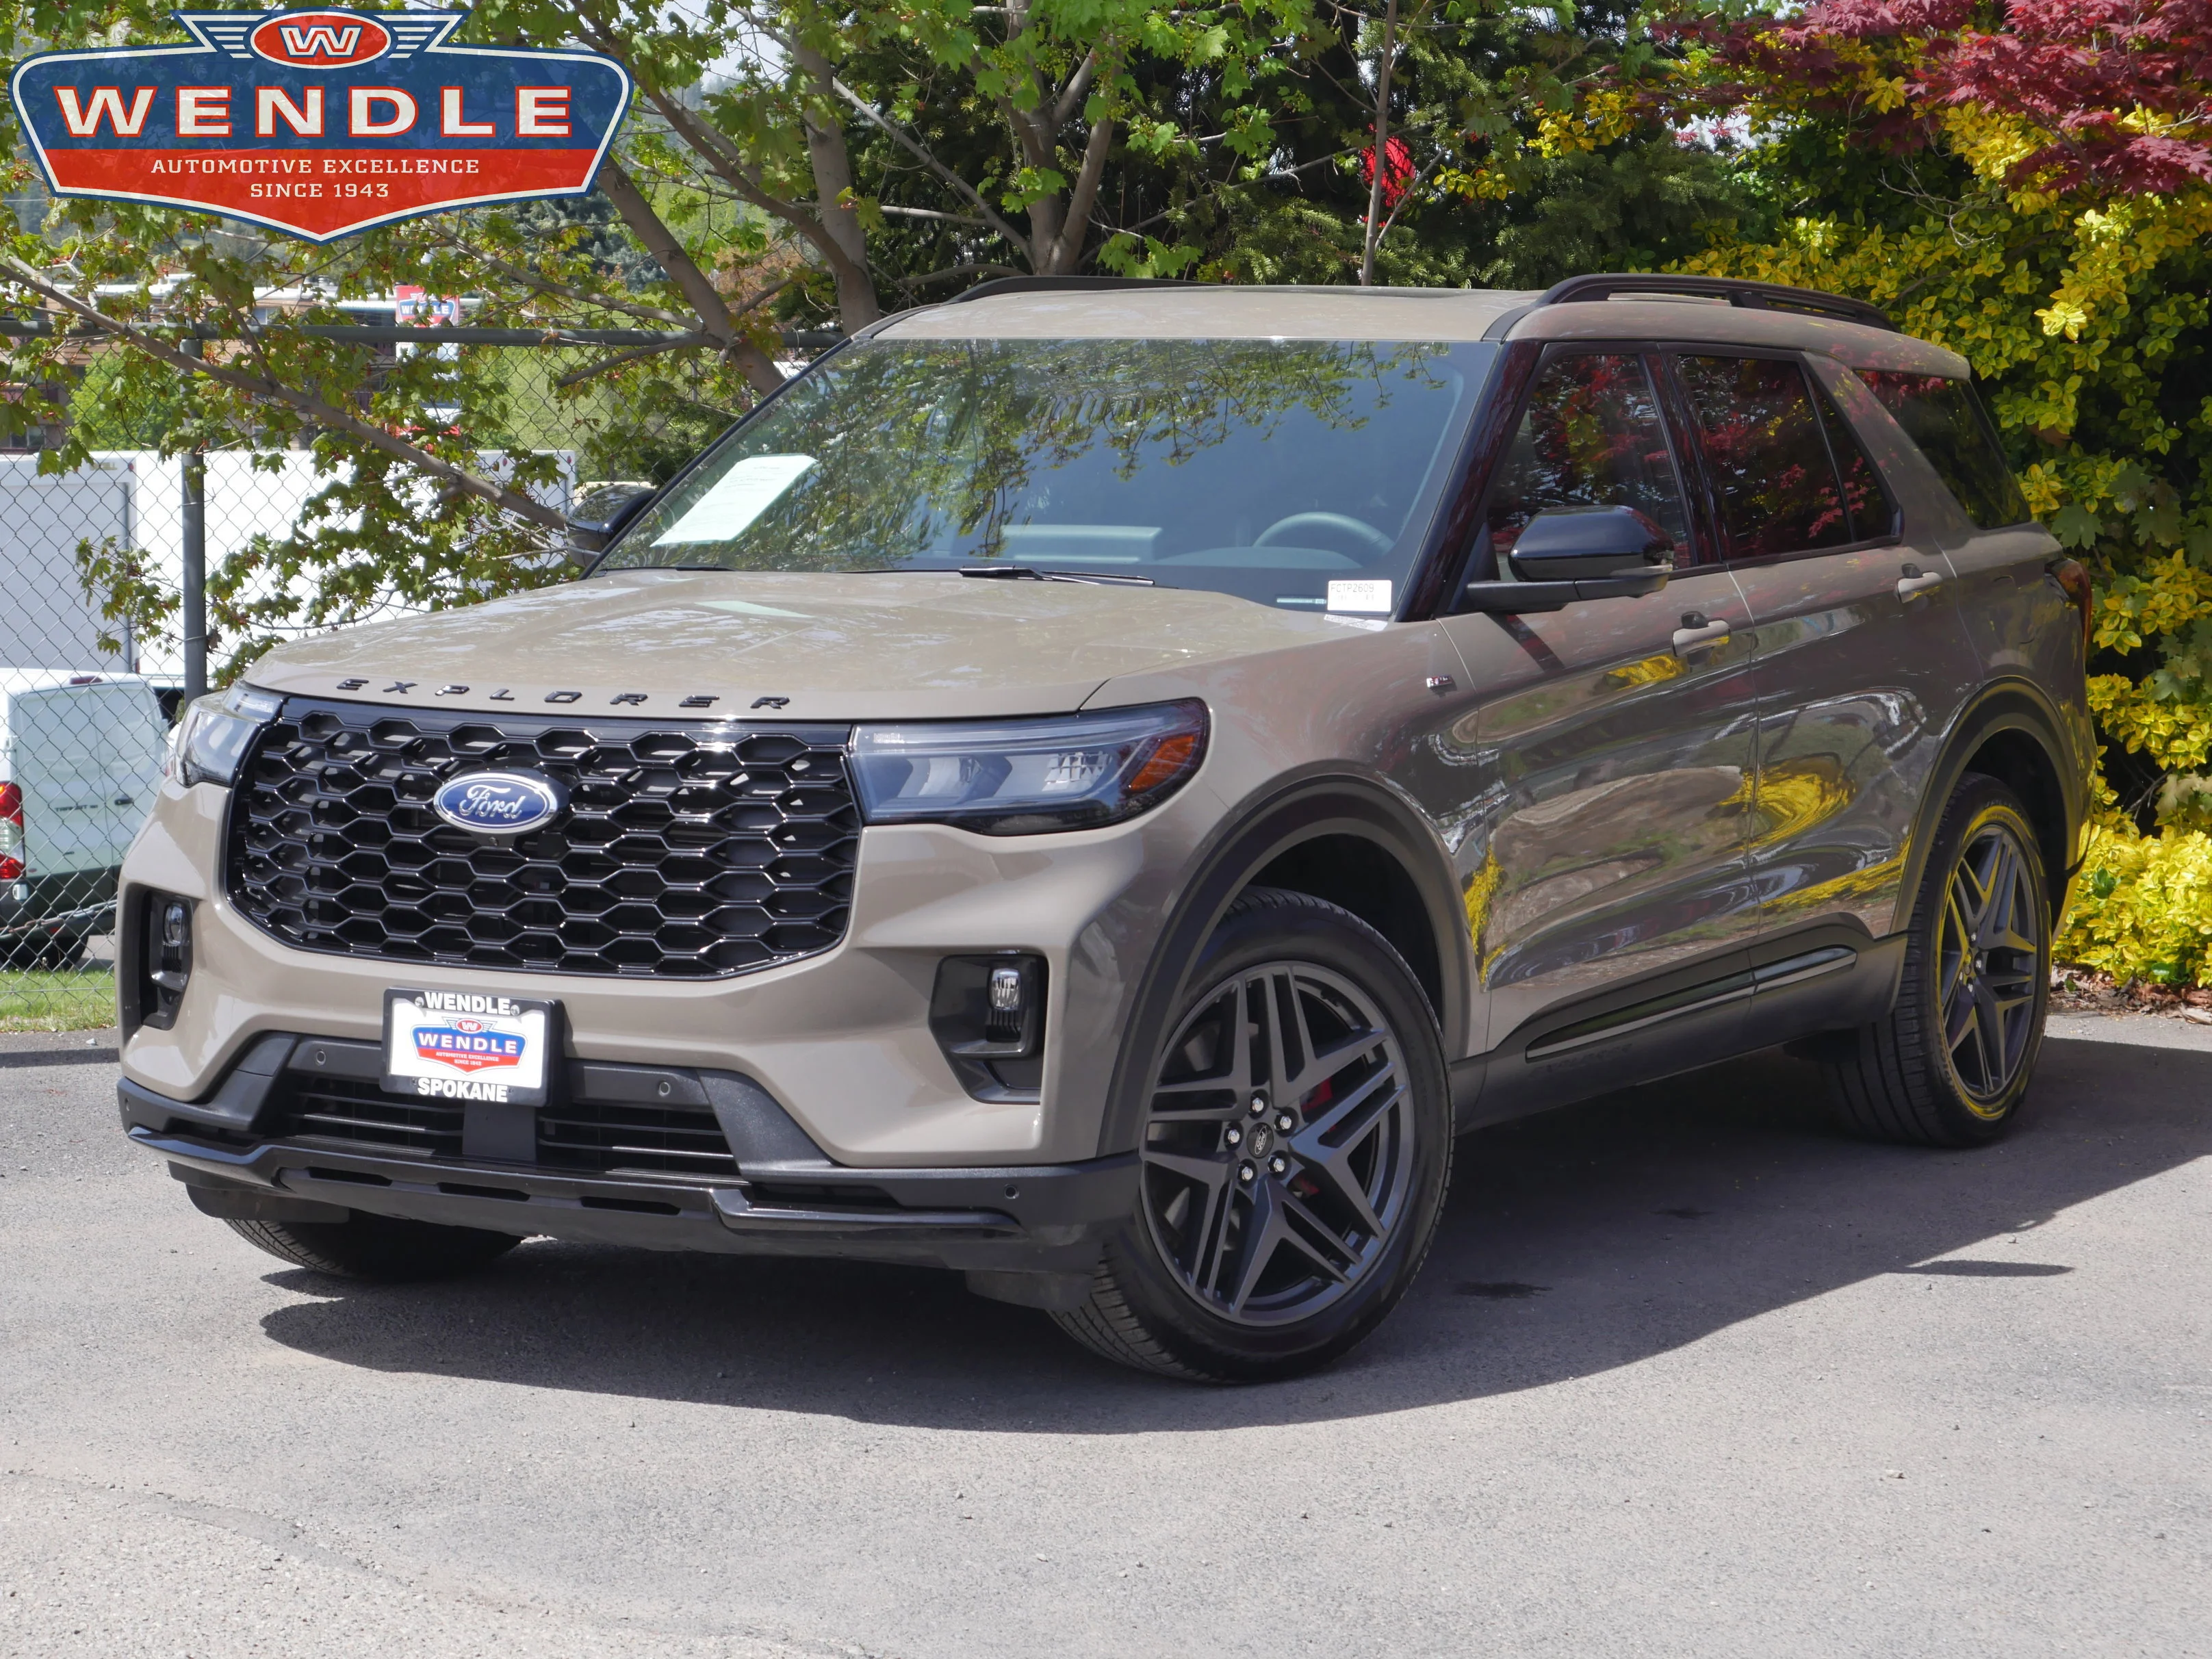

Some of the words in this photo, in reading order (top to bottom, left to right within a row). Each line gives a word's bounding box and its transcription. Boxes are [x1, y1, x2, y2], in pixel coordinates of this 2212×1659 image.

[335, 678, 790, 710] EXPLORER
[459, 784, 526, 819] Ford
[424, 992, 511, 1015] WENDLE
[418, 1032, 517, 1054] WENDLE
[417, 1077, 508, 1103] SPOKANE
